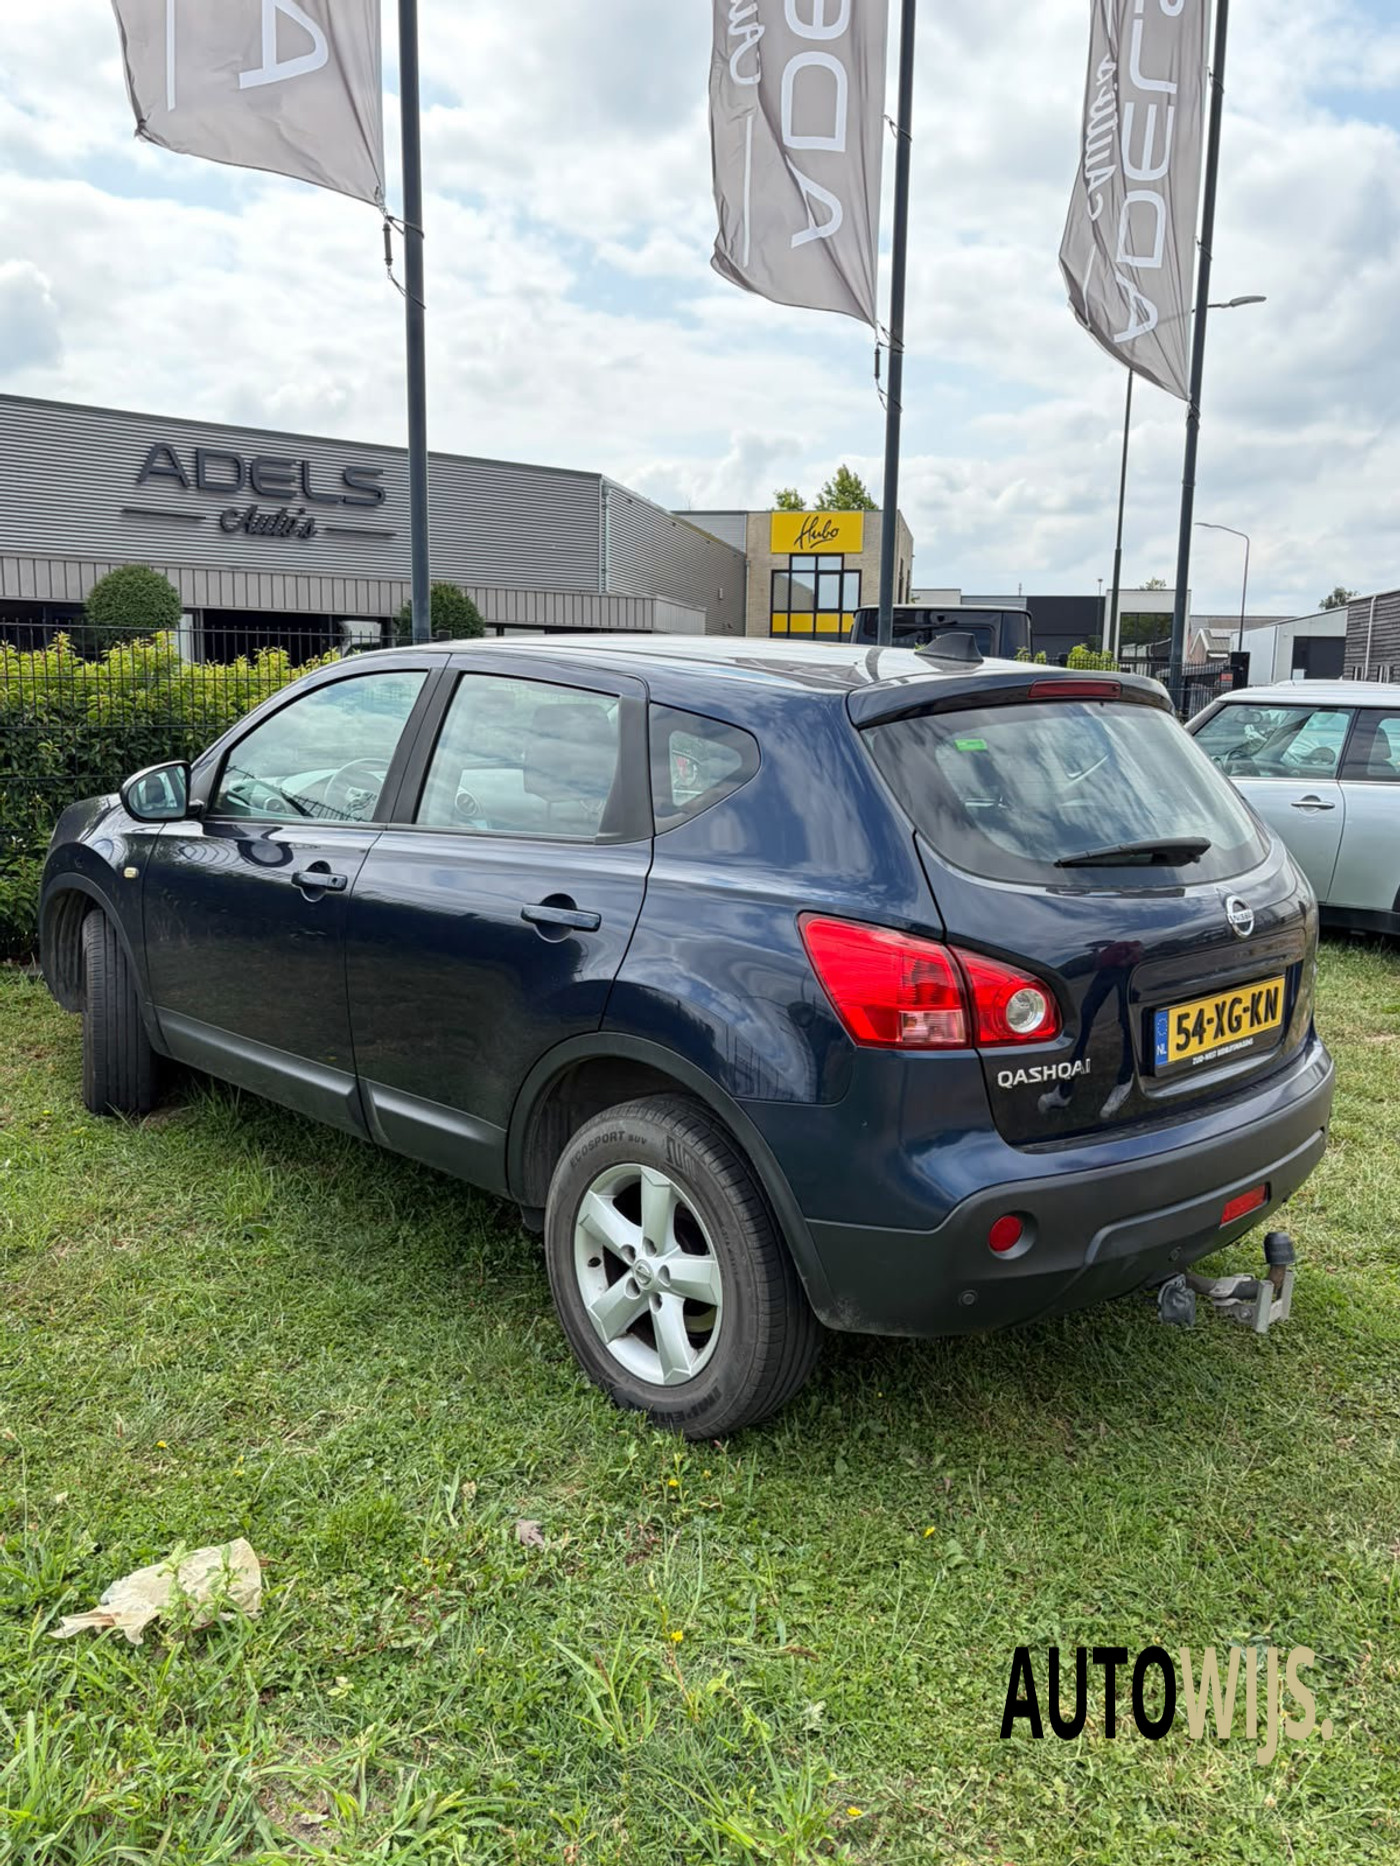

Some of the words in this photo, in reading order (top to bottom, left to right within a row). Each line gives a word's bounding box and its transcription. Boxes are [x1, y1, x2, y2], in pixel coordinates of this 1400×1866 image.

[136, 442, 386, 507] ADELS
[794, 515, 840, 550] Hubo
[1176, 986, 1279, 1051] 54-XG-KN
[1156, 1043, 1167, 1056] NL
[997, 1058, 1091, 1089] QASHQAI
[570, 1131, 626, 1168] ECOSPORT
